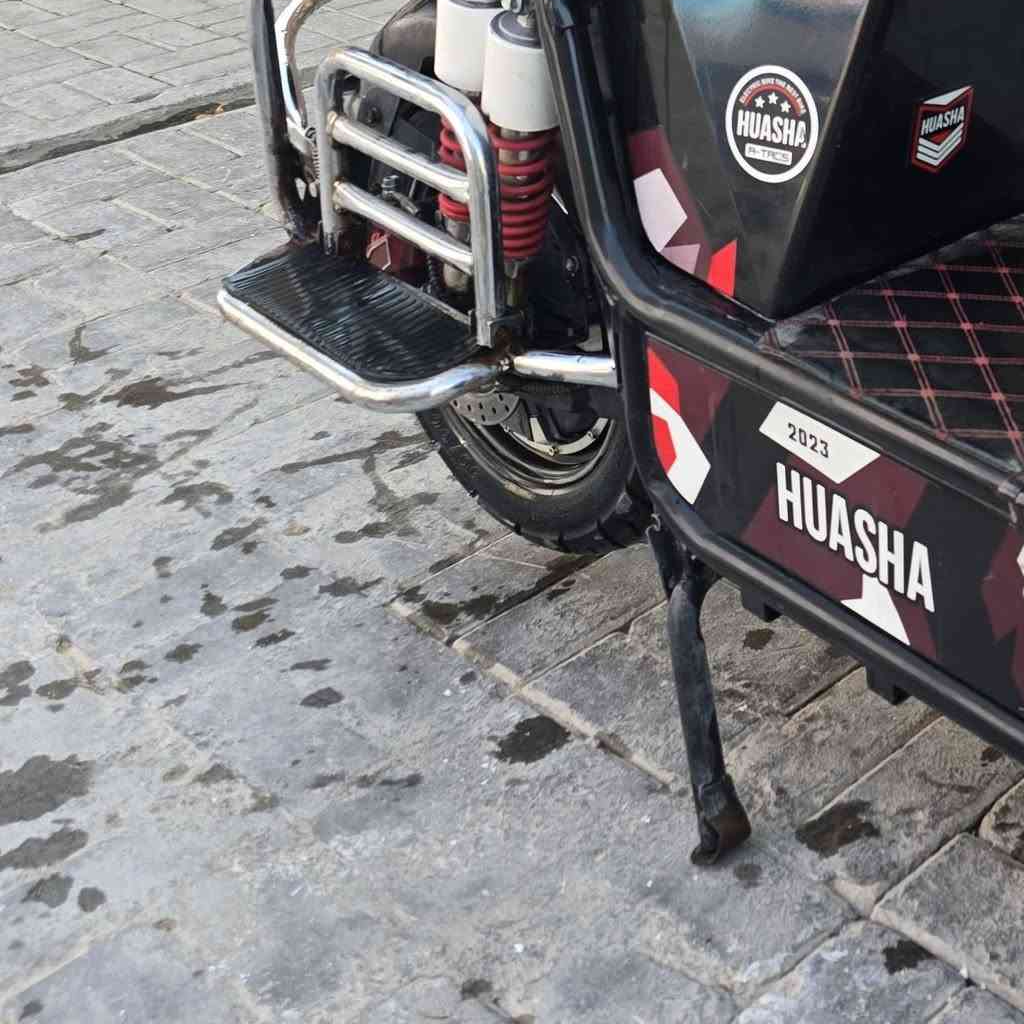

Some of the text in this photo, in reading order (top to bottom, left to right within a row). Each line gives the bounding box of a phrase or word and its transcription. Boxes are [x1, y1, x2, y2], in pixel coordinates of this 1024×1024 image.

[736, 109, 807, 148] HUASHA
[921, 106, 965, 135] HUASHA
[788, 422, 830, 458] 2023
[776, 462, 935, 613] HUASHA
